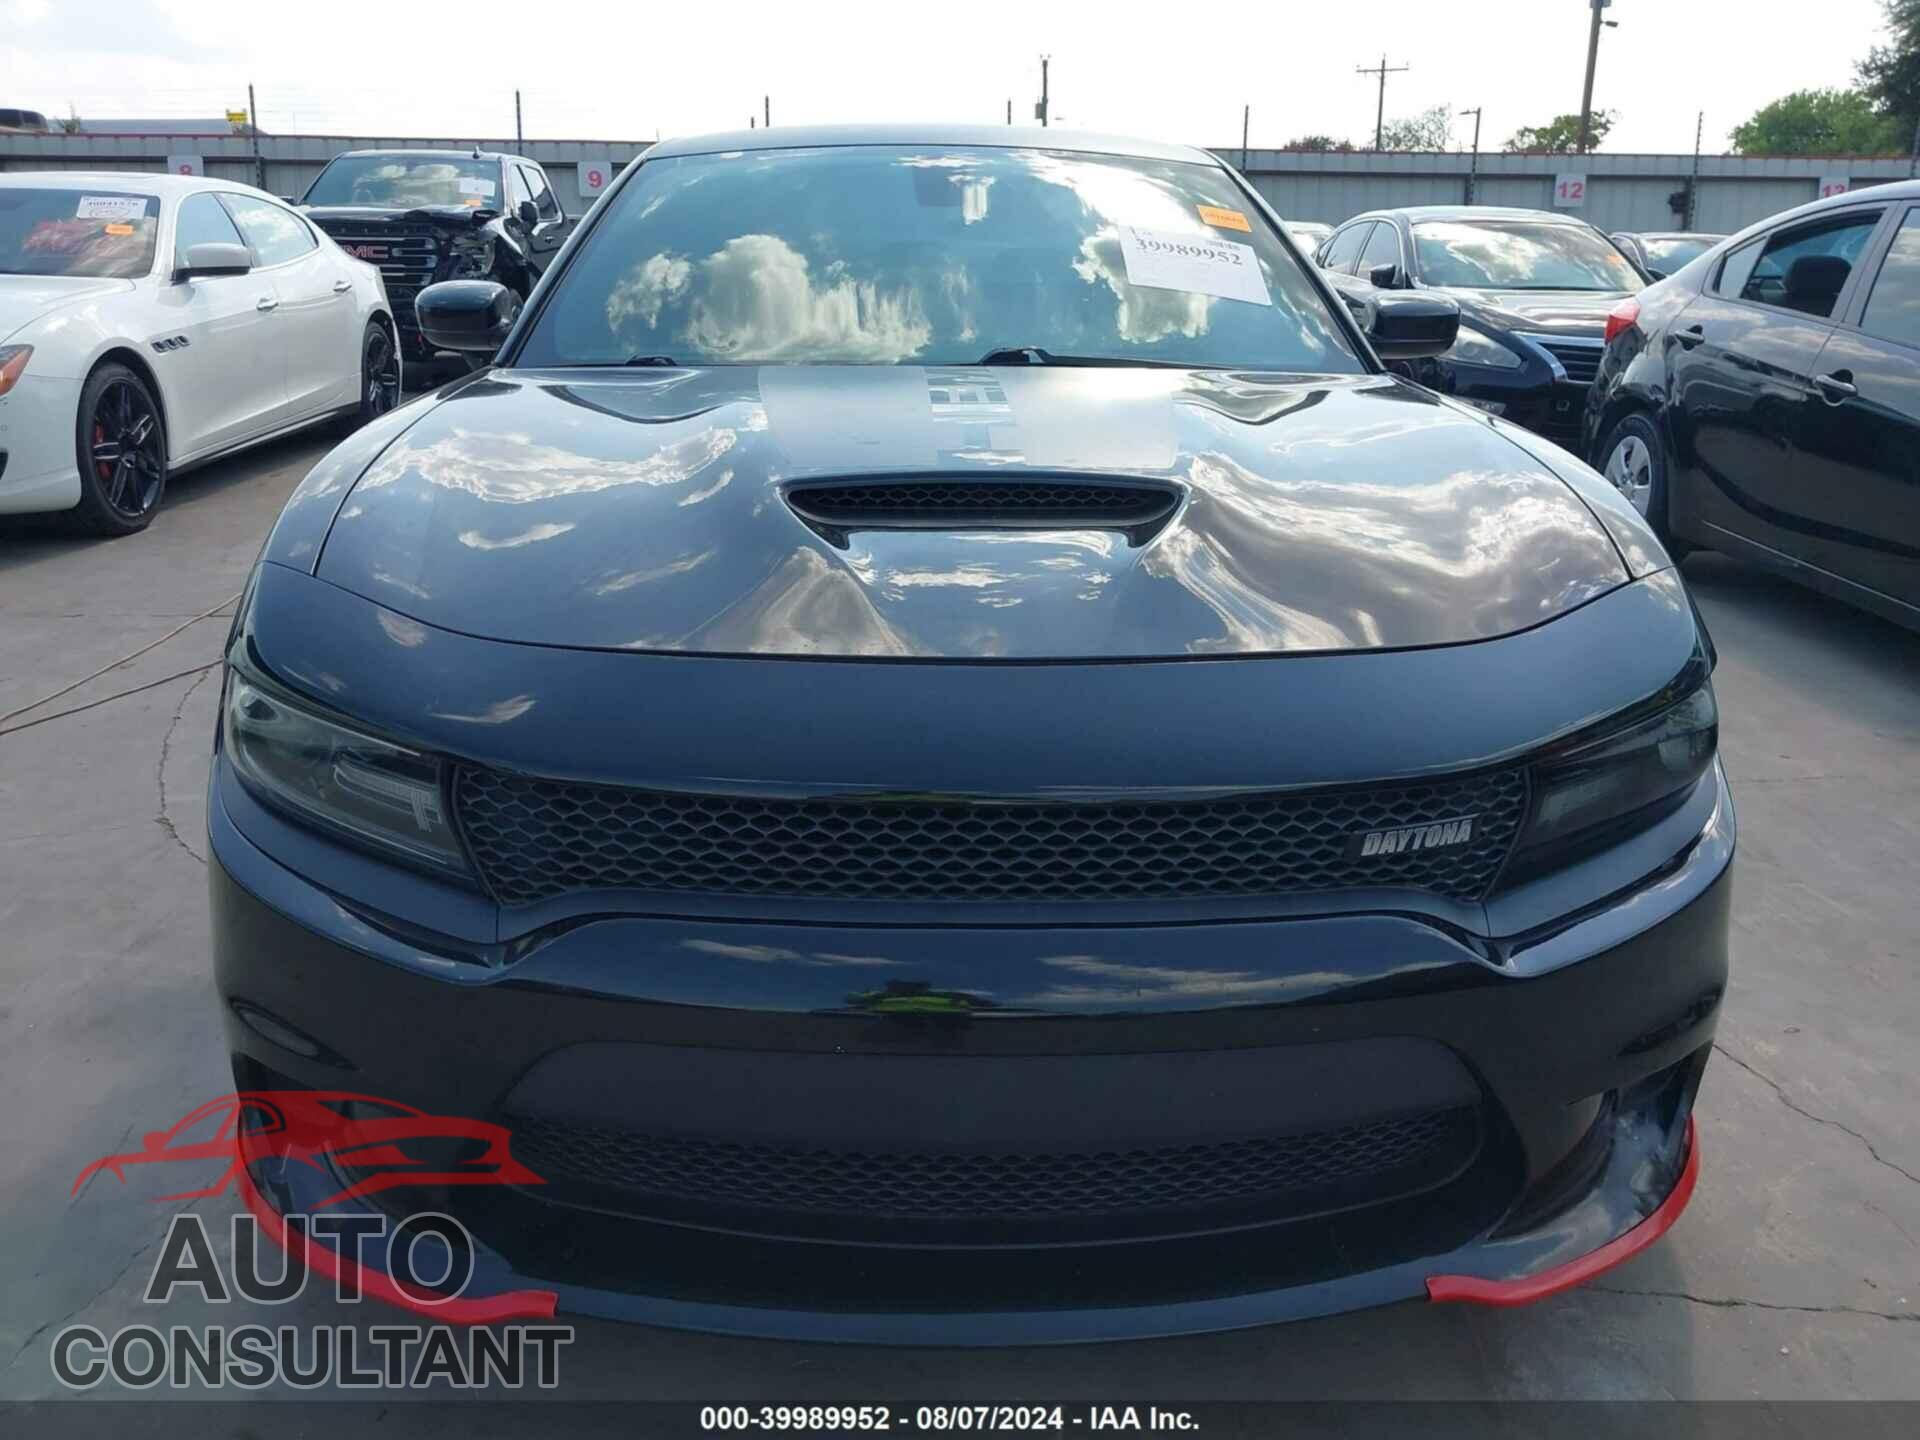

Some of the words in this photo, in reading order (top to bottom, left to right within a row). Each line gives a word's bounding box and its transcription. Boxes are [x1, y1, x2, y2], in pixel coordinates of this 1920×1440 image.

[587, 170, 603, 188] 9
[1557, 181, 1584, 199] 12
[343, 245, 389, 259] MC
[1135, 238, 1243, 266] 39989952
[1361, 819, 1473, 857] DAYTONA
